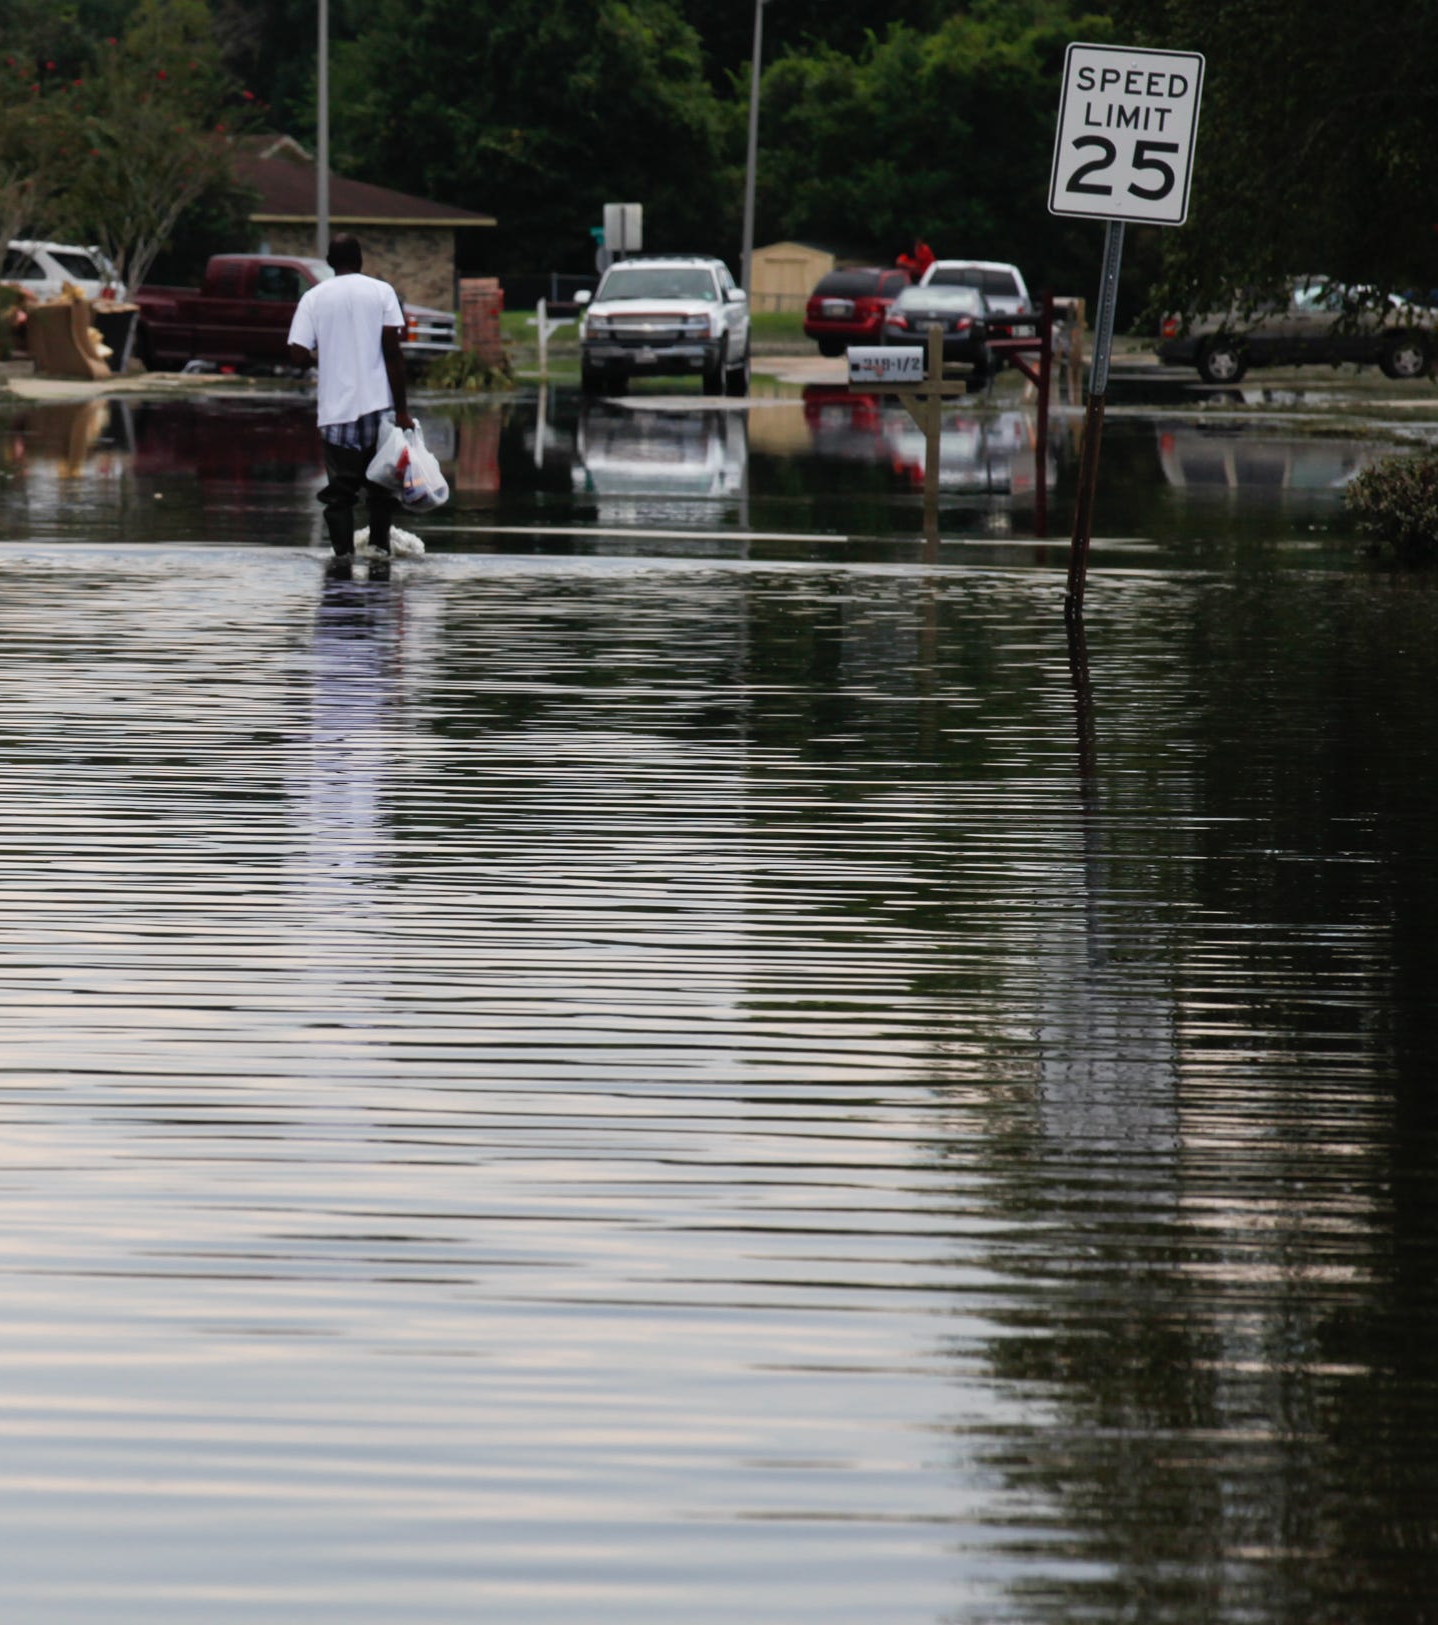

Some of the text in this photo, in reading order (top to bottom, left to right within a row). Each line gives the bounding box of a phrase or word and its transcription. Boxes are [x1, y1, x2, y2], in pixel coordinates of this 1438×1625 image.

[1076, 66, 1189, 98] SPEED
[1084, 101, 1173, 132] LIMIT
[1065, 135, 1180, 201] 25
